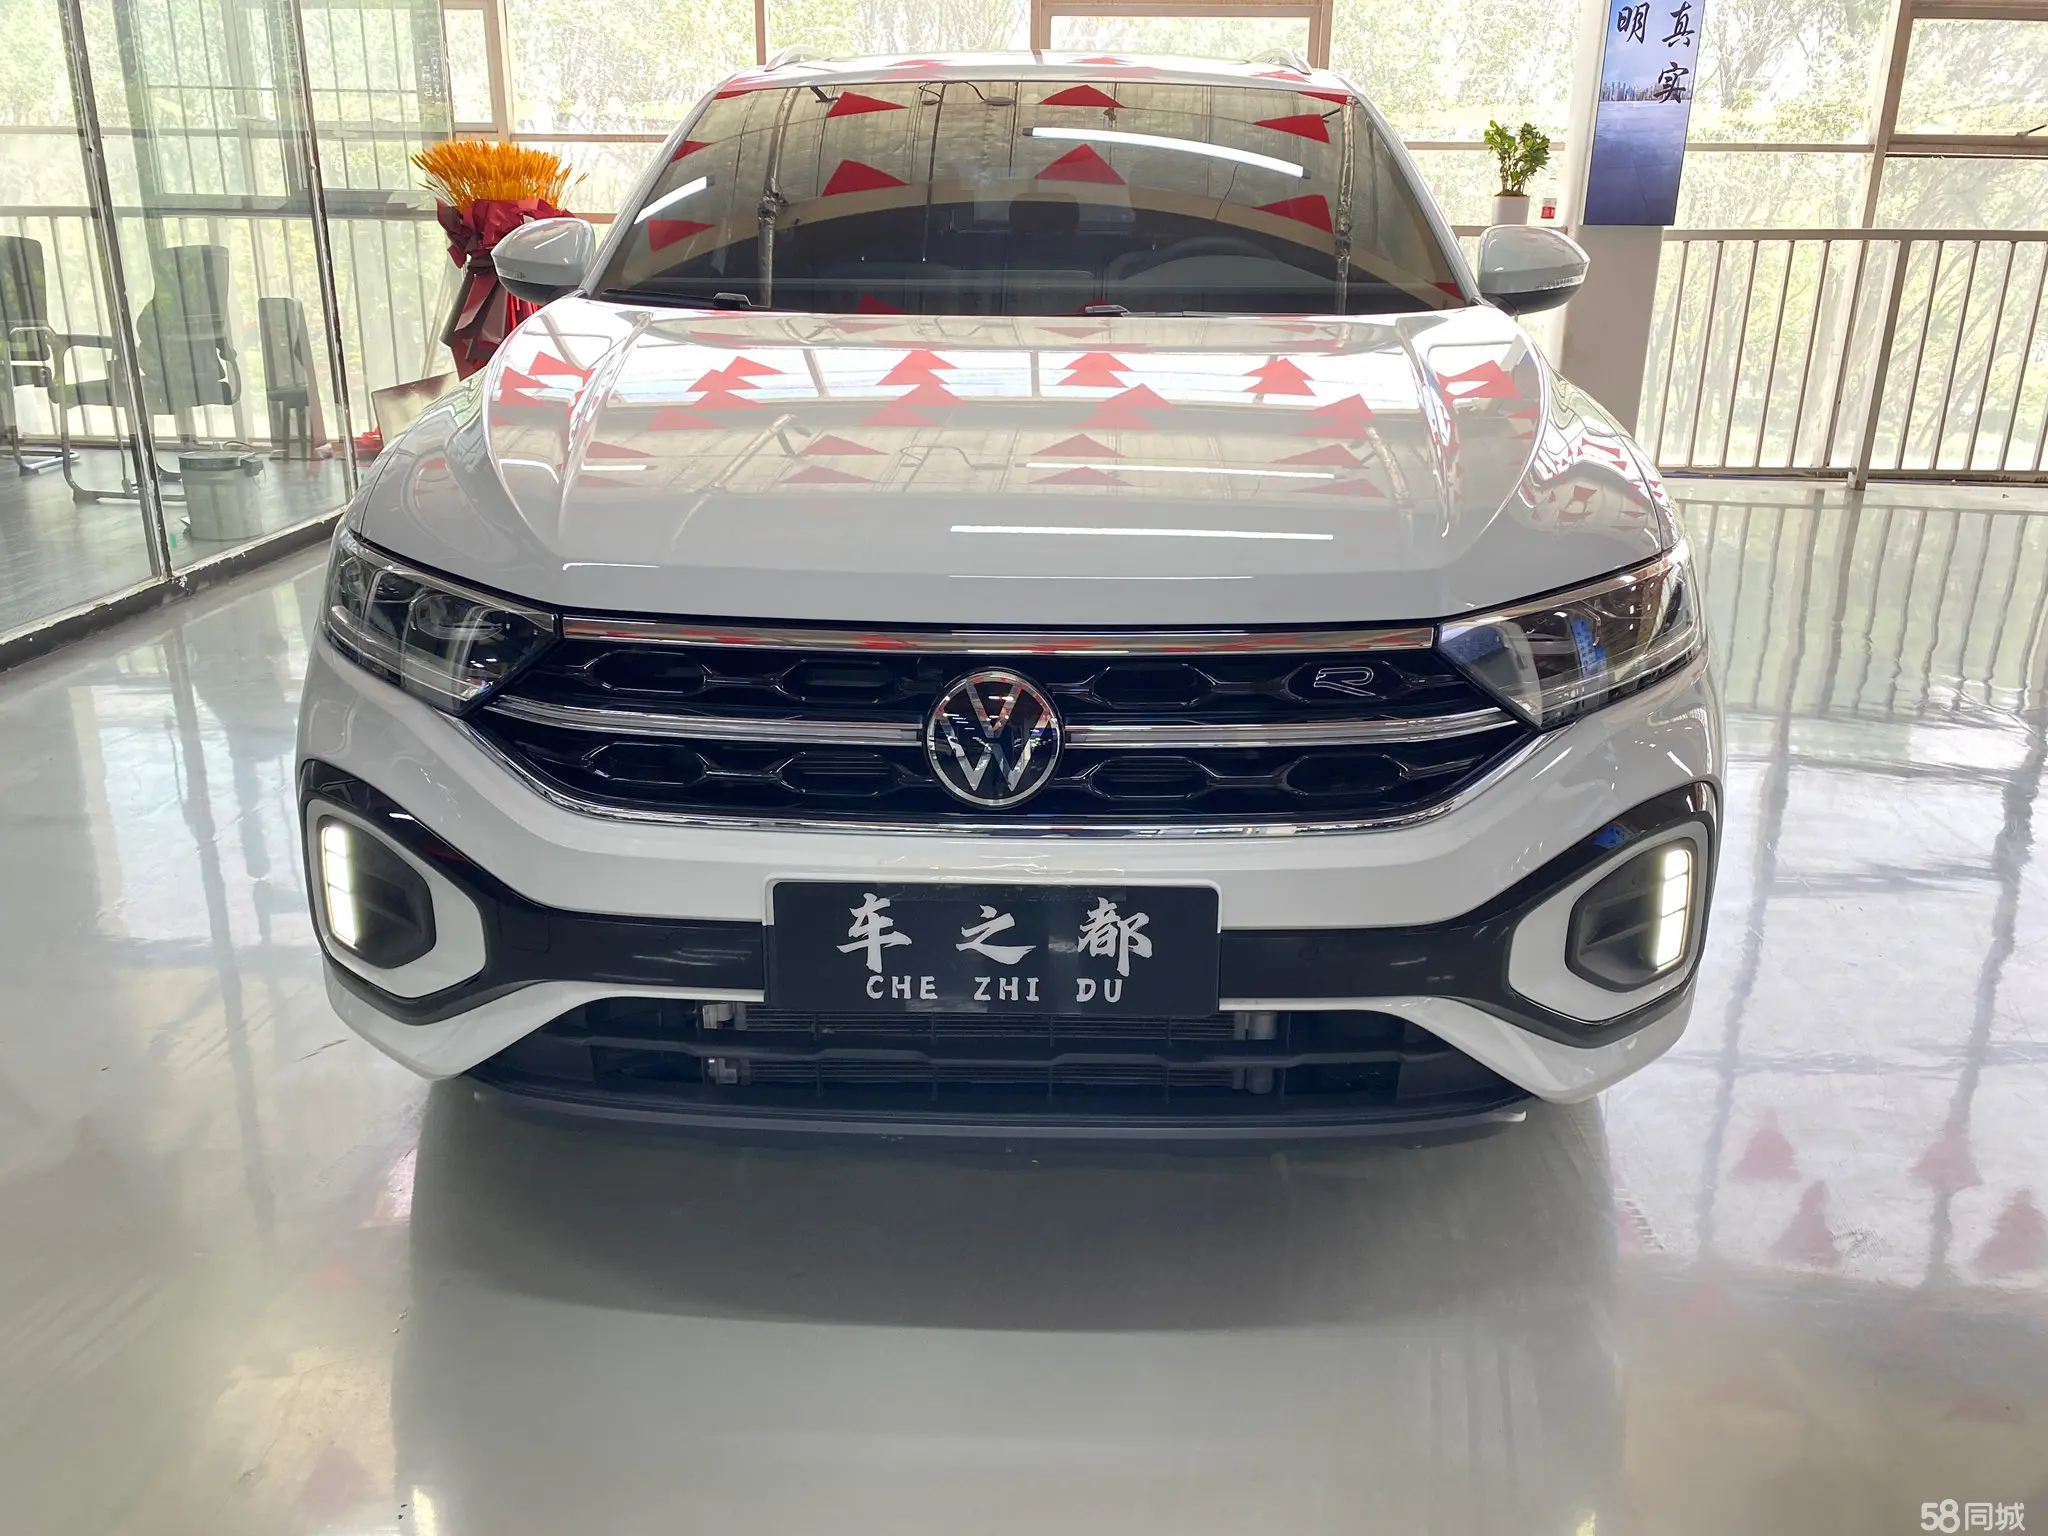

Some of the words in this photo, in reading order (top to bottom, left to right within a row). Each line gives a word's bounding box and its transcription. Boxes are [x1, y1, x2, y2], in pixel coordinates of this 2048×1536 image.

[1617, 1, 1650, 44] 明
[1653, 1, 1695, 104] 真实
[836, 892, 1153, 977] 车之都
[866, 974, 938, 1000] CHE
[973, 976, 1040, 1002] ZHI
[1076, 977, 1123, 1003] DU
